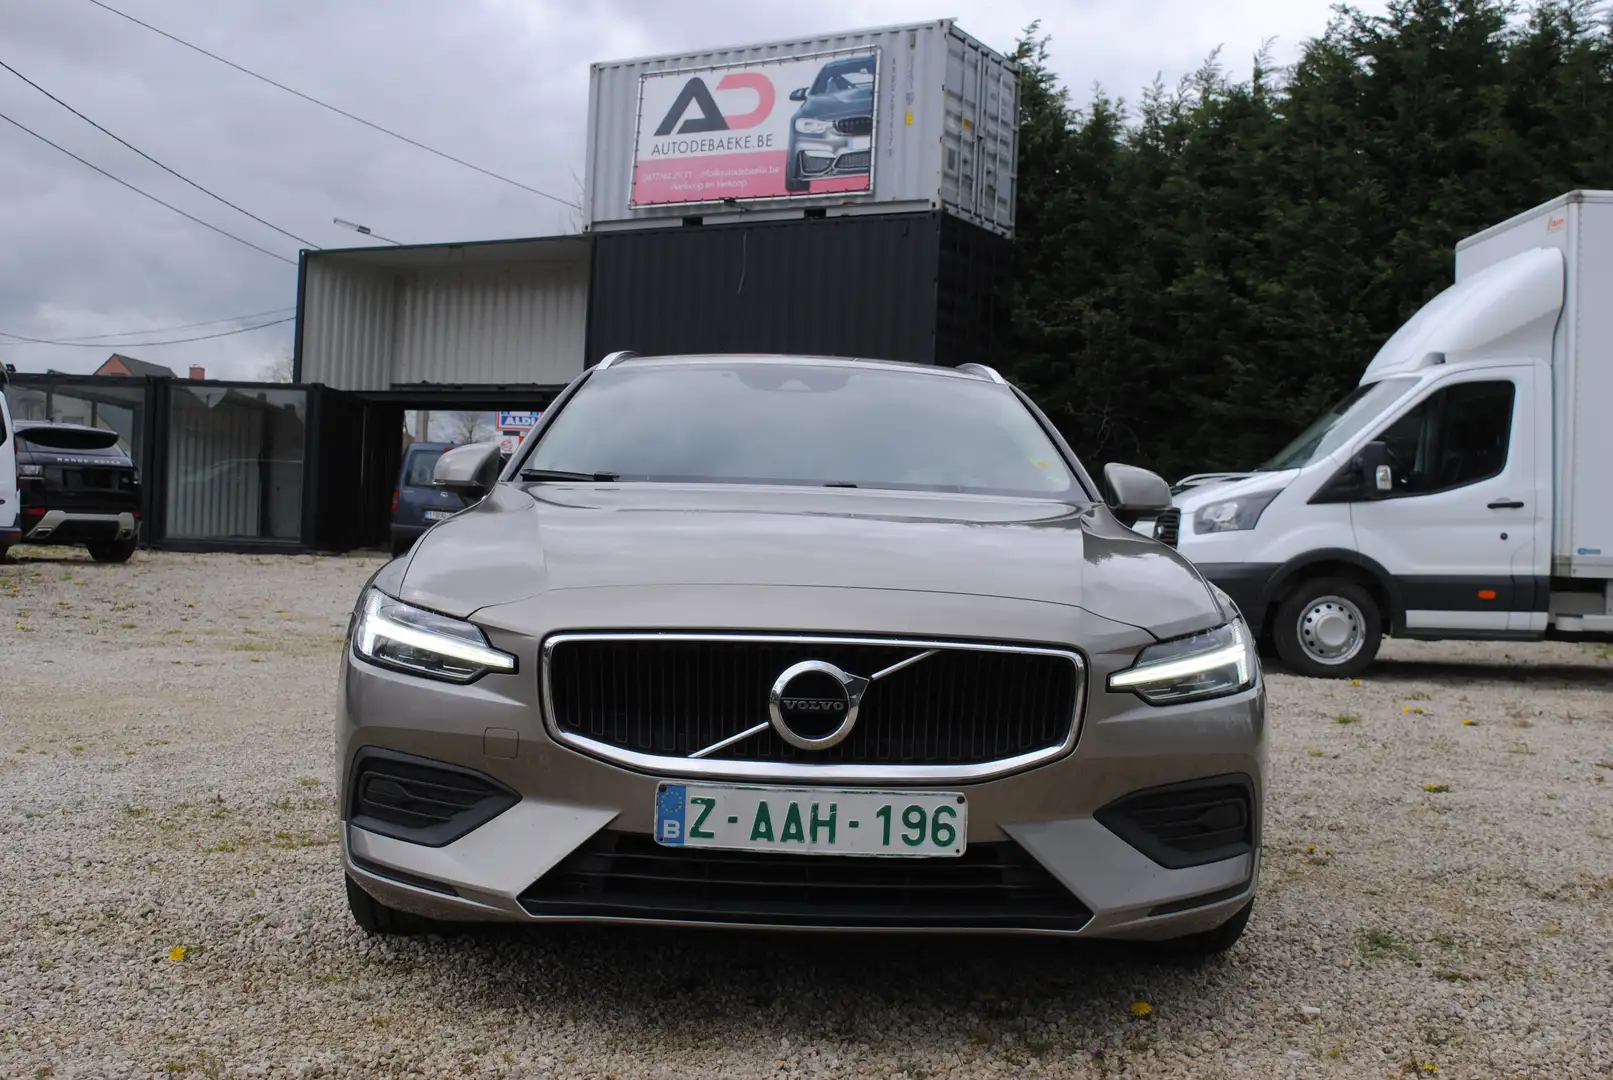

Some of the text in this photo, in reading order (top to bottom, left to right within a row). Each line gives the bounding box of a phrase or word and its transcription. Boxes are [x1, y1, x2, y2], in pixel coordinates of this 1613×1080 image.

[651, 134, 773, 156] AUTODEBAEKE.BE
[505, 415, 536, 425] ALDI
[783, 699, 844, 711] VOLVO
[663, 819, 681, 839] B
